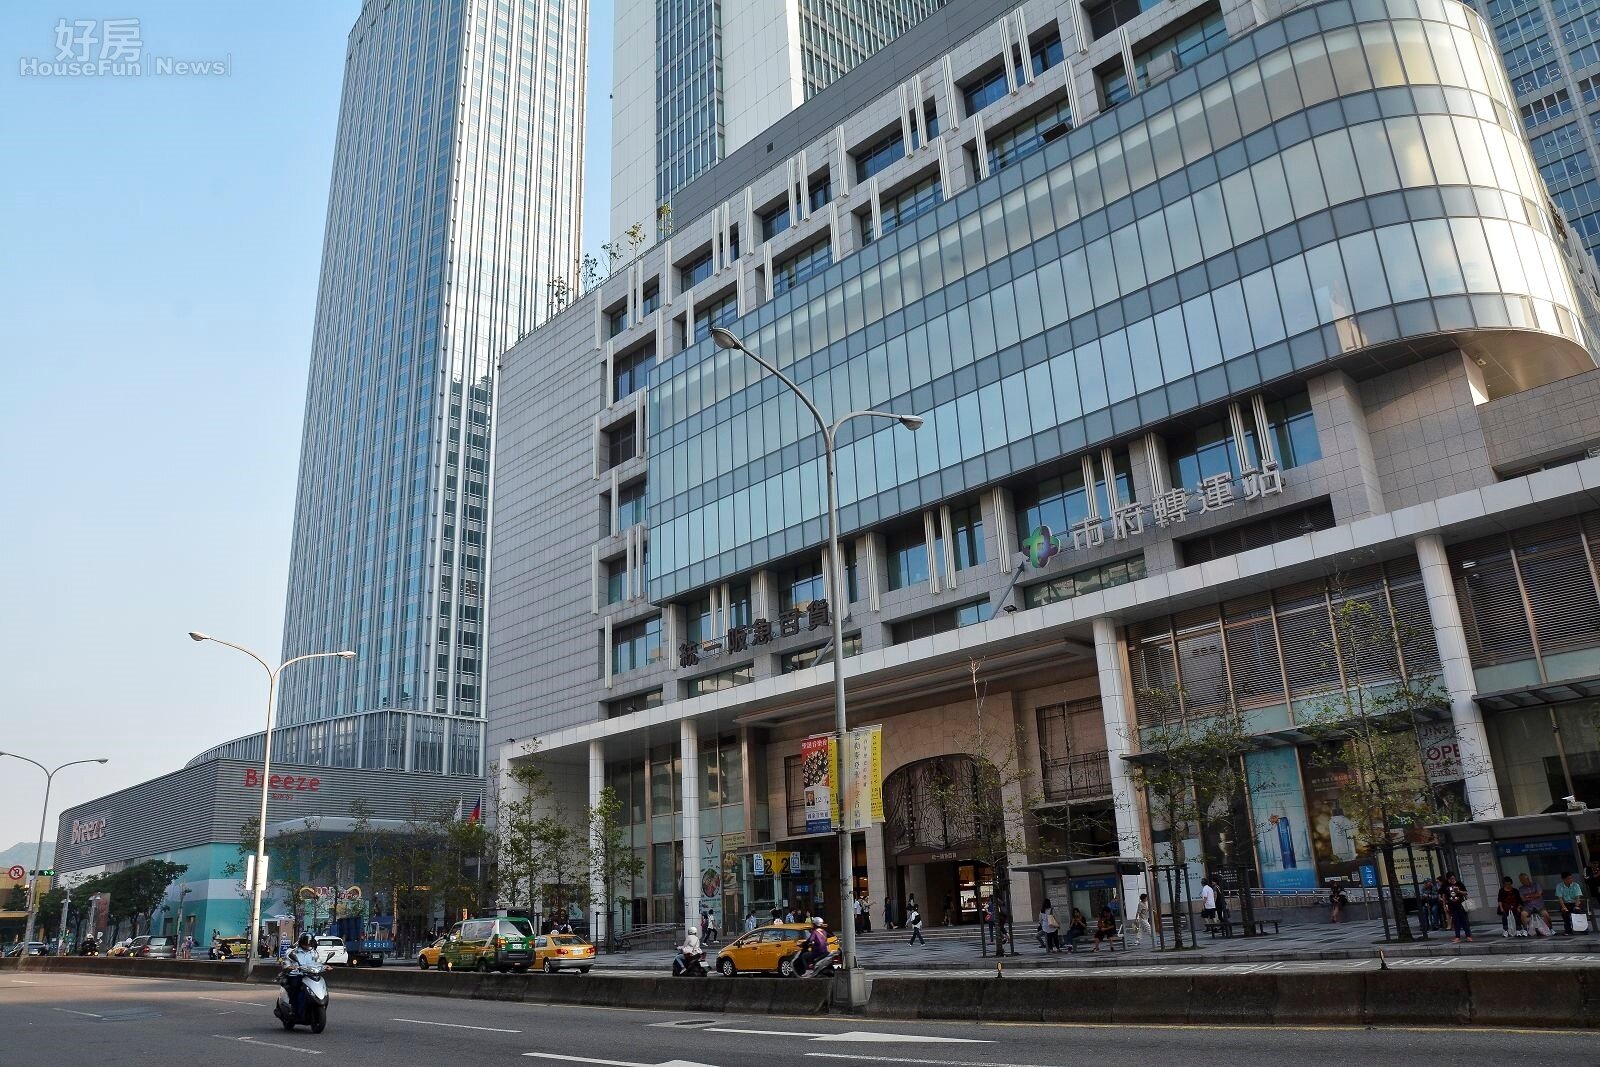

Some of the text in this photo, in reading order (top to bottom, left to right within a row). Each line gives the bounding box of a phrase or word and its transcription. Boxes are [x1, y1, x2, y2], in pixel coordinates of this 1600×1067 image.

[1071, 459, 1283, 551] 市府轉運站
[679, 599, 830, 668] 統一阪急百貨
[244, 768, 321, 792] Breeze
[71, 817, 106, 844] Breeze
[765, 859, 772, 874] 2
[781, 858, 790, 873] 2
